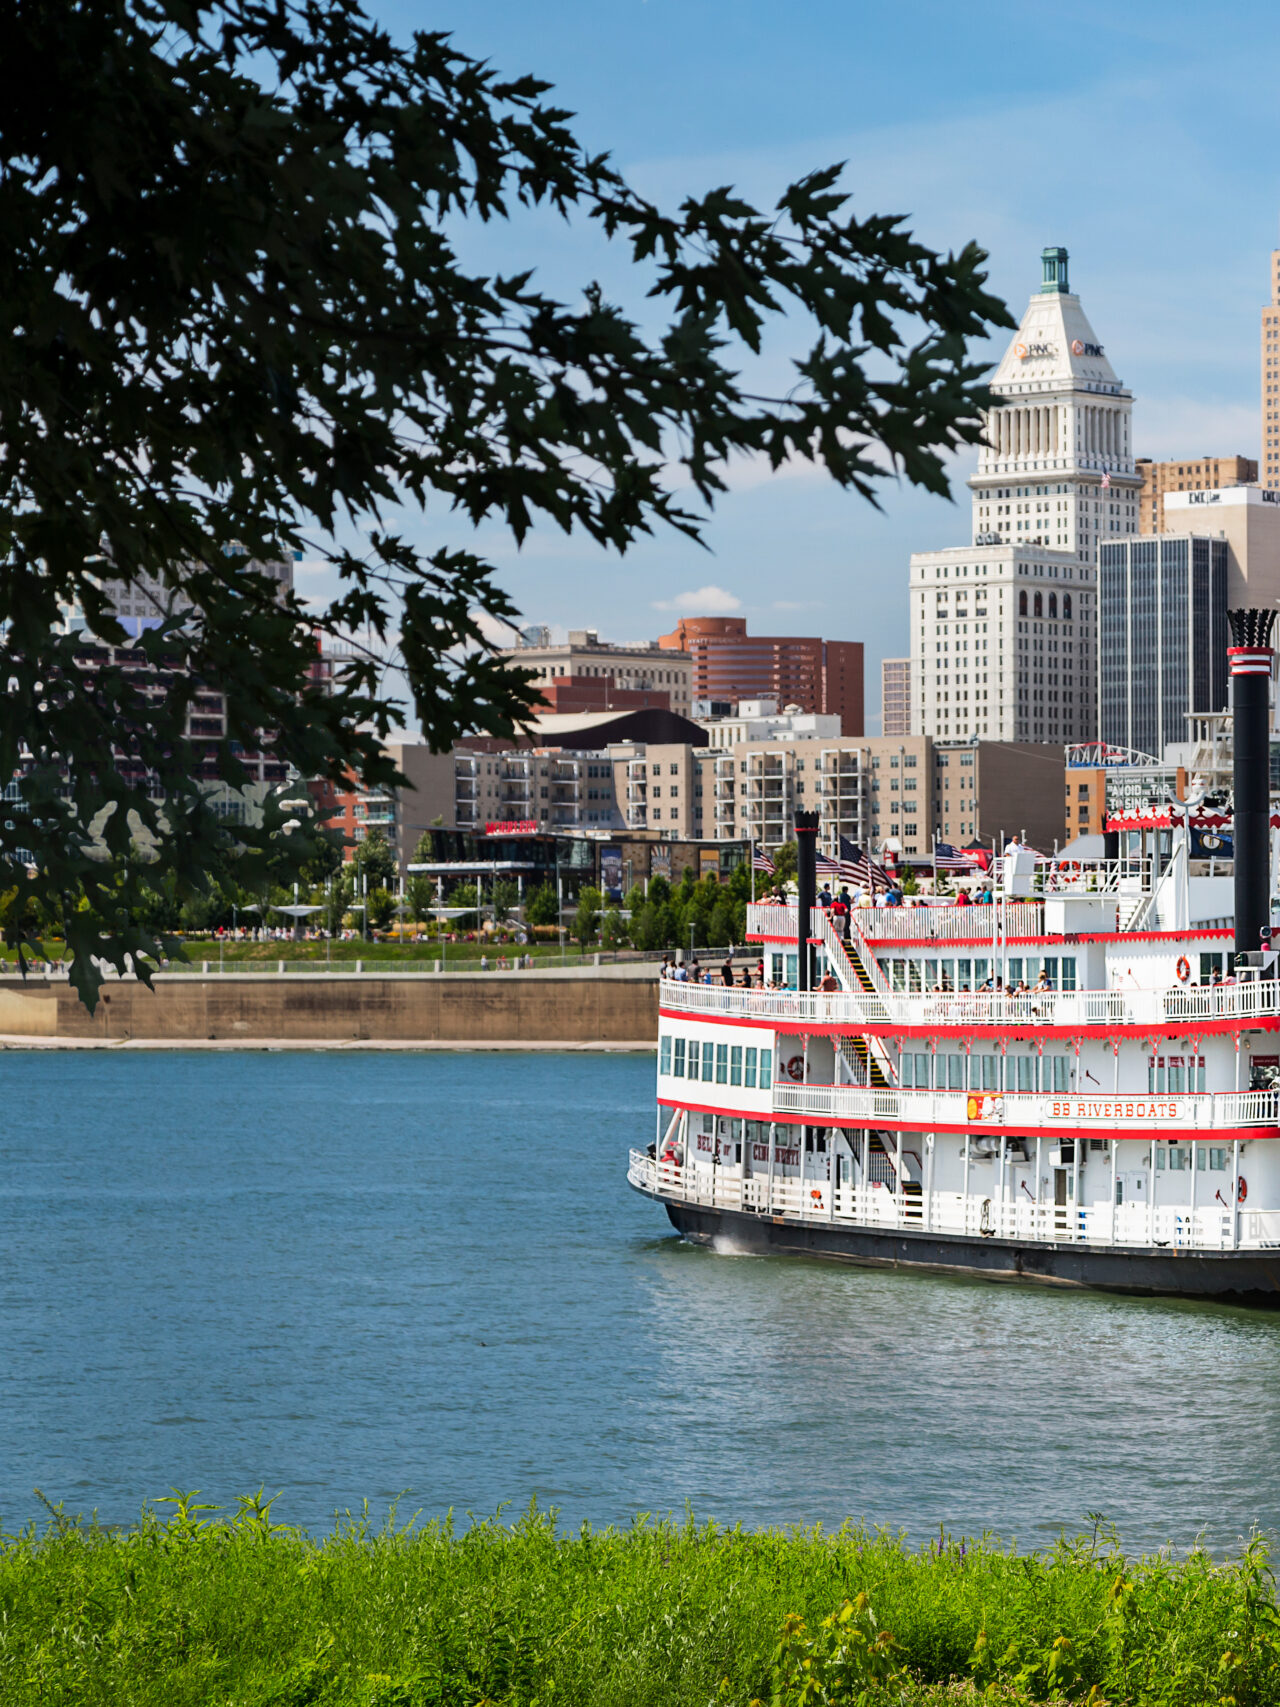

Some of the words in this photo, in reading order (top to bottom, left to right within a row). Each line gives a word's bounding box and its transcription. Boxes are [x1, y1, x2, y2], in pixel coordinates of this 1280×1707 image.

[1029, 343, 1054, 356] PNC
[1084, 343, 1105, 357] PNC
[1124, 797, 1149, 810] SING
[485, 820, 537, 834] MOERLEIN
[1052, 1102, 1071, 1117] BB
[1077, 1103, 1177, 1117] RIVERBOATS
